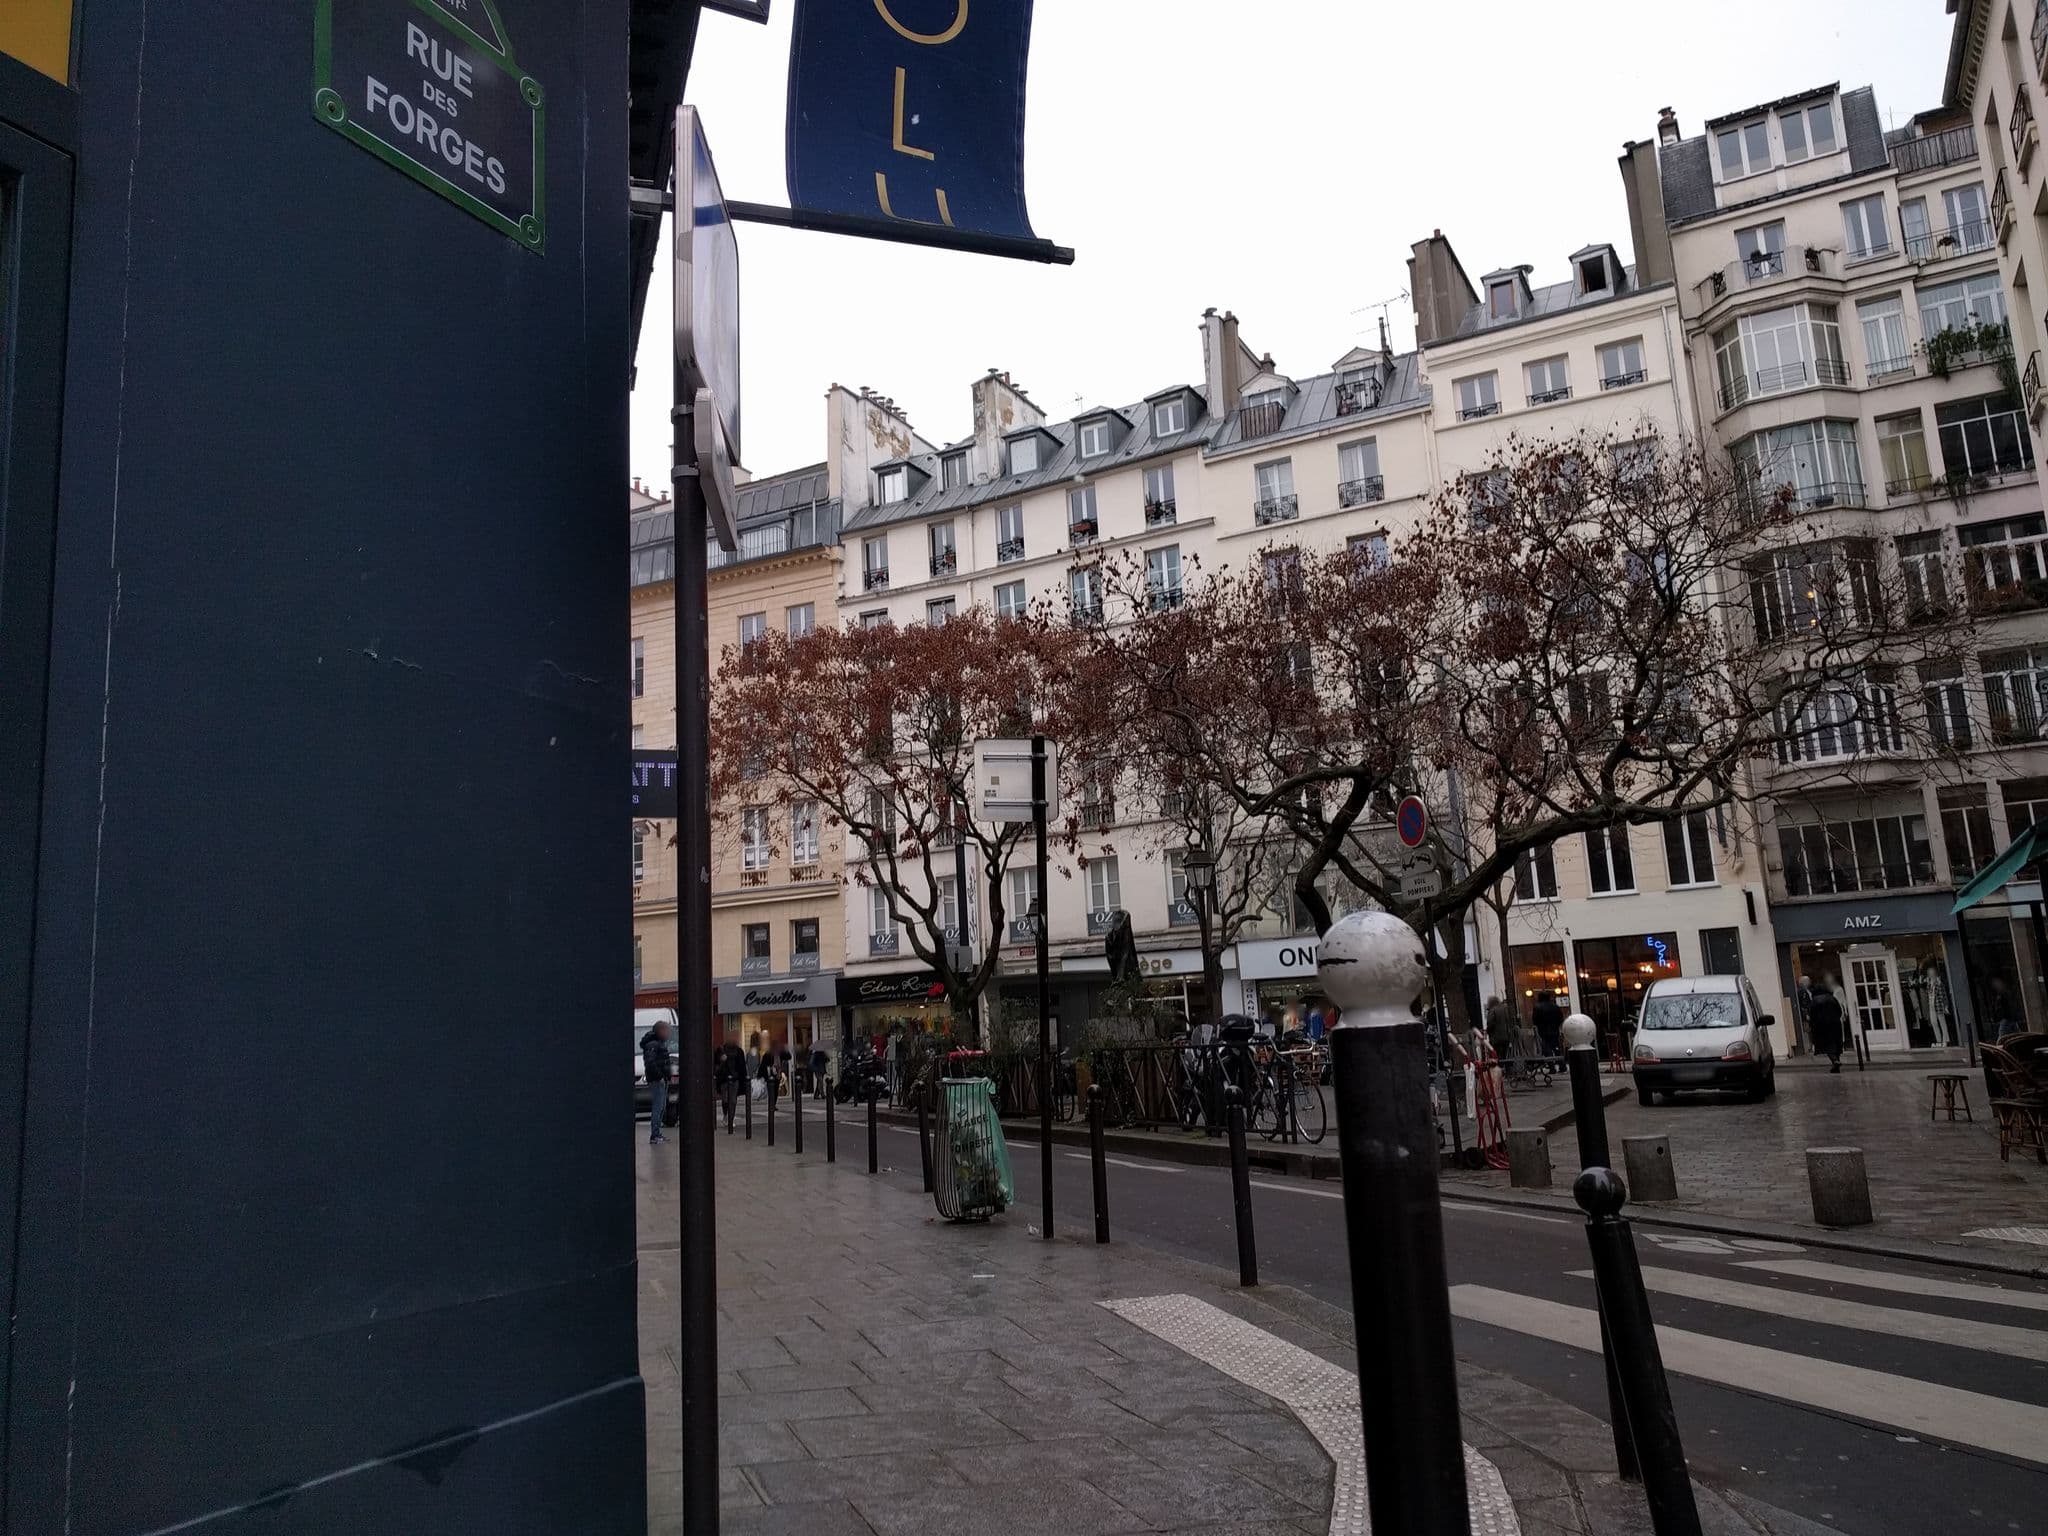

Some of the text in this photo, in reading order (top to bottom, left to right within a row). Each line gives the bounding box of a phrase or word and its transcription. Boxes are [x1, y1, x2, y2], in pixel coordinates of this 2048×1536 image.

[407, 20, 473, 99] RUE
[422, 79, 458, 118] DES
[366, 75, 506, 195] FORGES
[1407, 884, 1435, 896] POMPIERS
[1414, 878, 1426, 888] VOIE
[1844, 914, 1882, 929] AMZ
[1279, 946, 1317, 967] ON
[859, 980, 899, 995] Eden
[743, 989, 807, 1006] Croisillon
